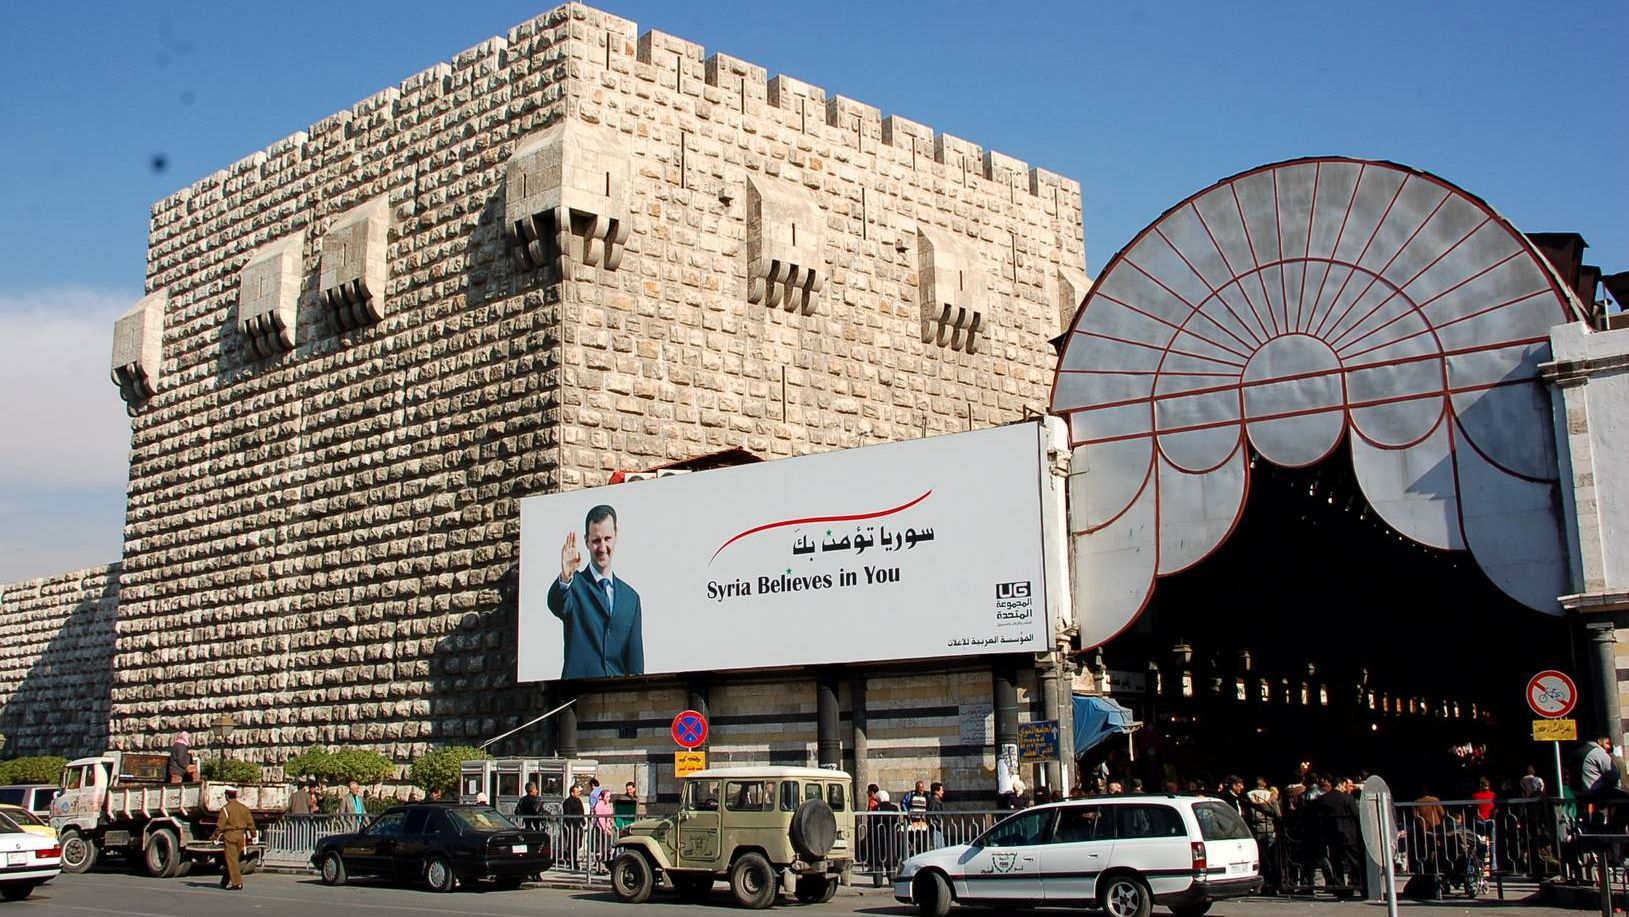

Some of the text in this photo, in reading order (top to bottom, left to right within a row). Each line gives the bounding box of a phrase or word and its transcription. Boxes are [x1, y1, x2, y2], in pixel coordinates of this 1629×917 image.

[880, 525, 935, 552] سوريا
[707, 565, 901, 603] Syria Believes in You
[996, 582, 1031, 599] UG
[996, 609, 1033, 620] المتحدة
